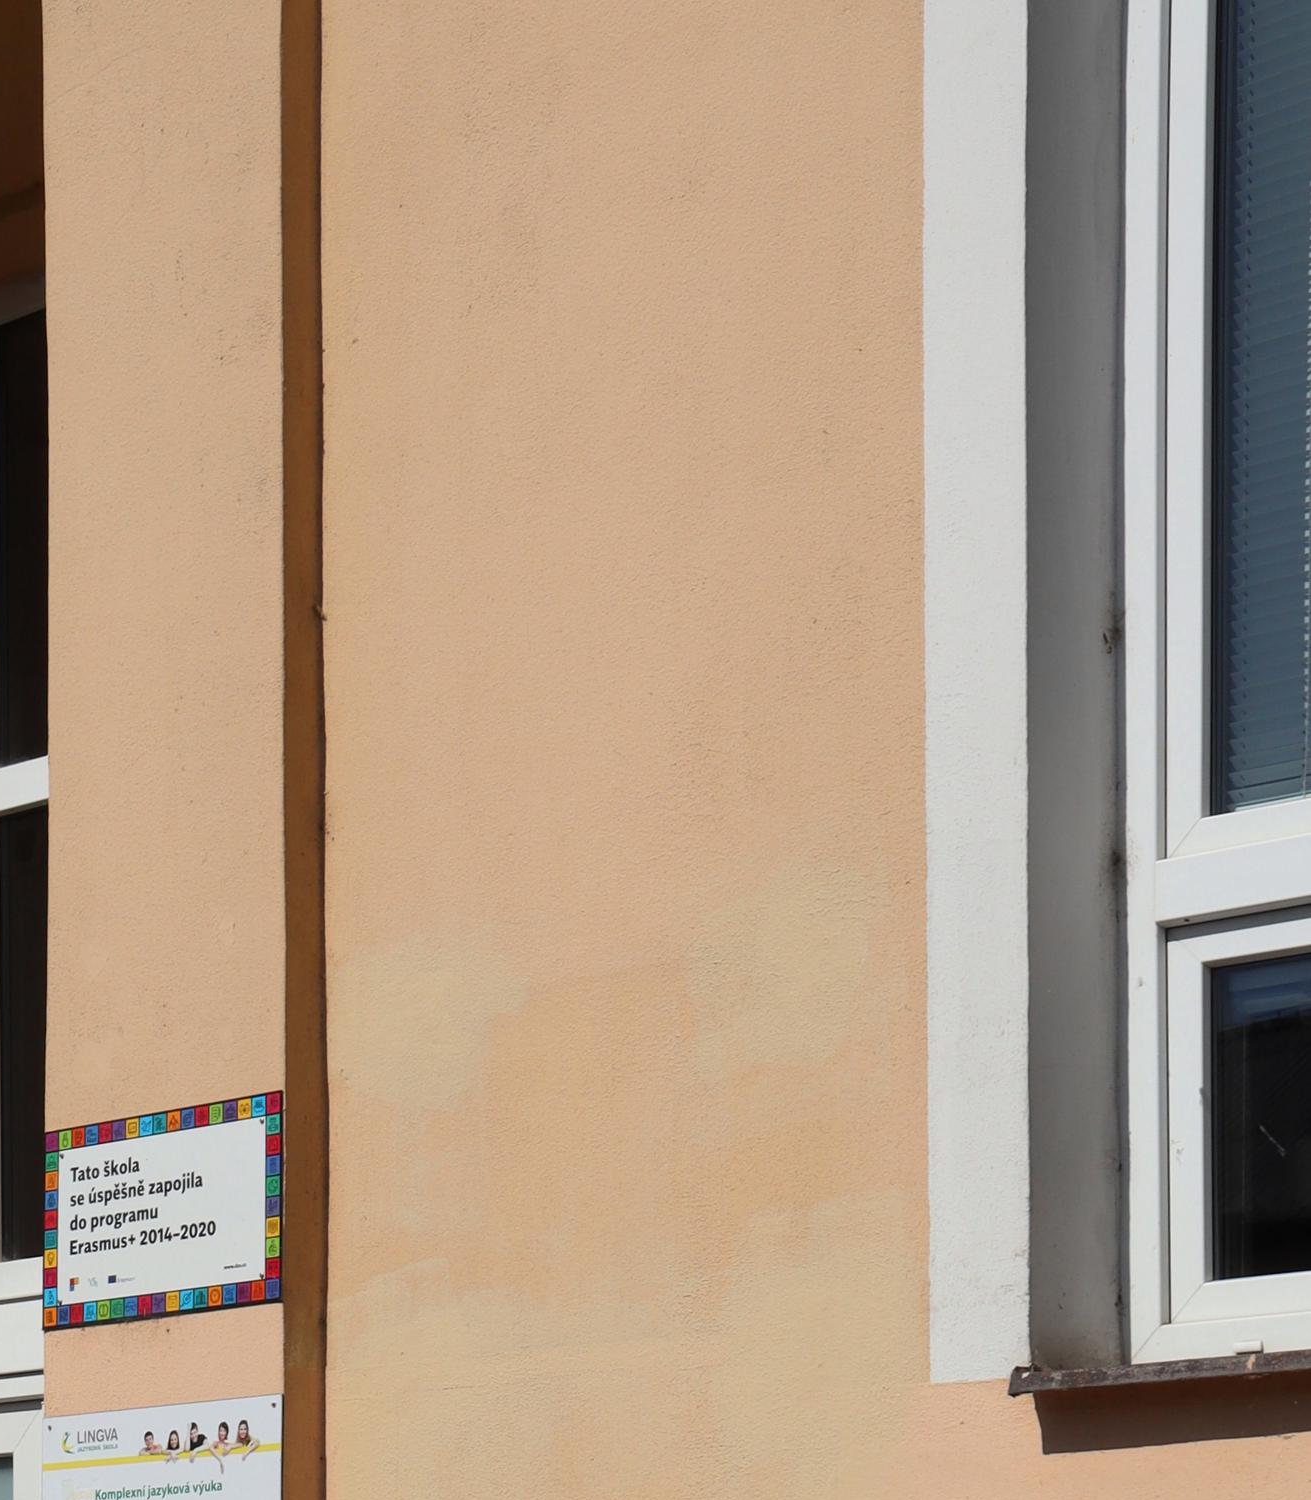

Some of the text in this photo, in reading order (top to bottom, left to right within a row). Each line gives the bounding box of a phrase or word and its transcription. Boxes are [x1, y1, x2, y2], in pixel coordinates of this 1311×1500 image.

[70, 1157, 140, 1182] Tato škola
[70, 1172, 203, 1207] se úspěšně zapojila
[69, 1207, 158, 1232] do programu
[69, 1235, 136, 1256] Erasmus+
[77, 1427, 118, 1444] LINGVA
[146, 1482, 190, 1499] jazyková
[193, 1480, 223, 1494] výuka
